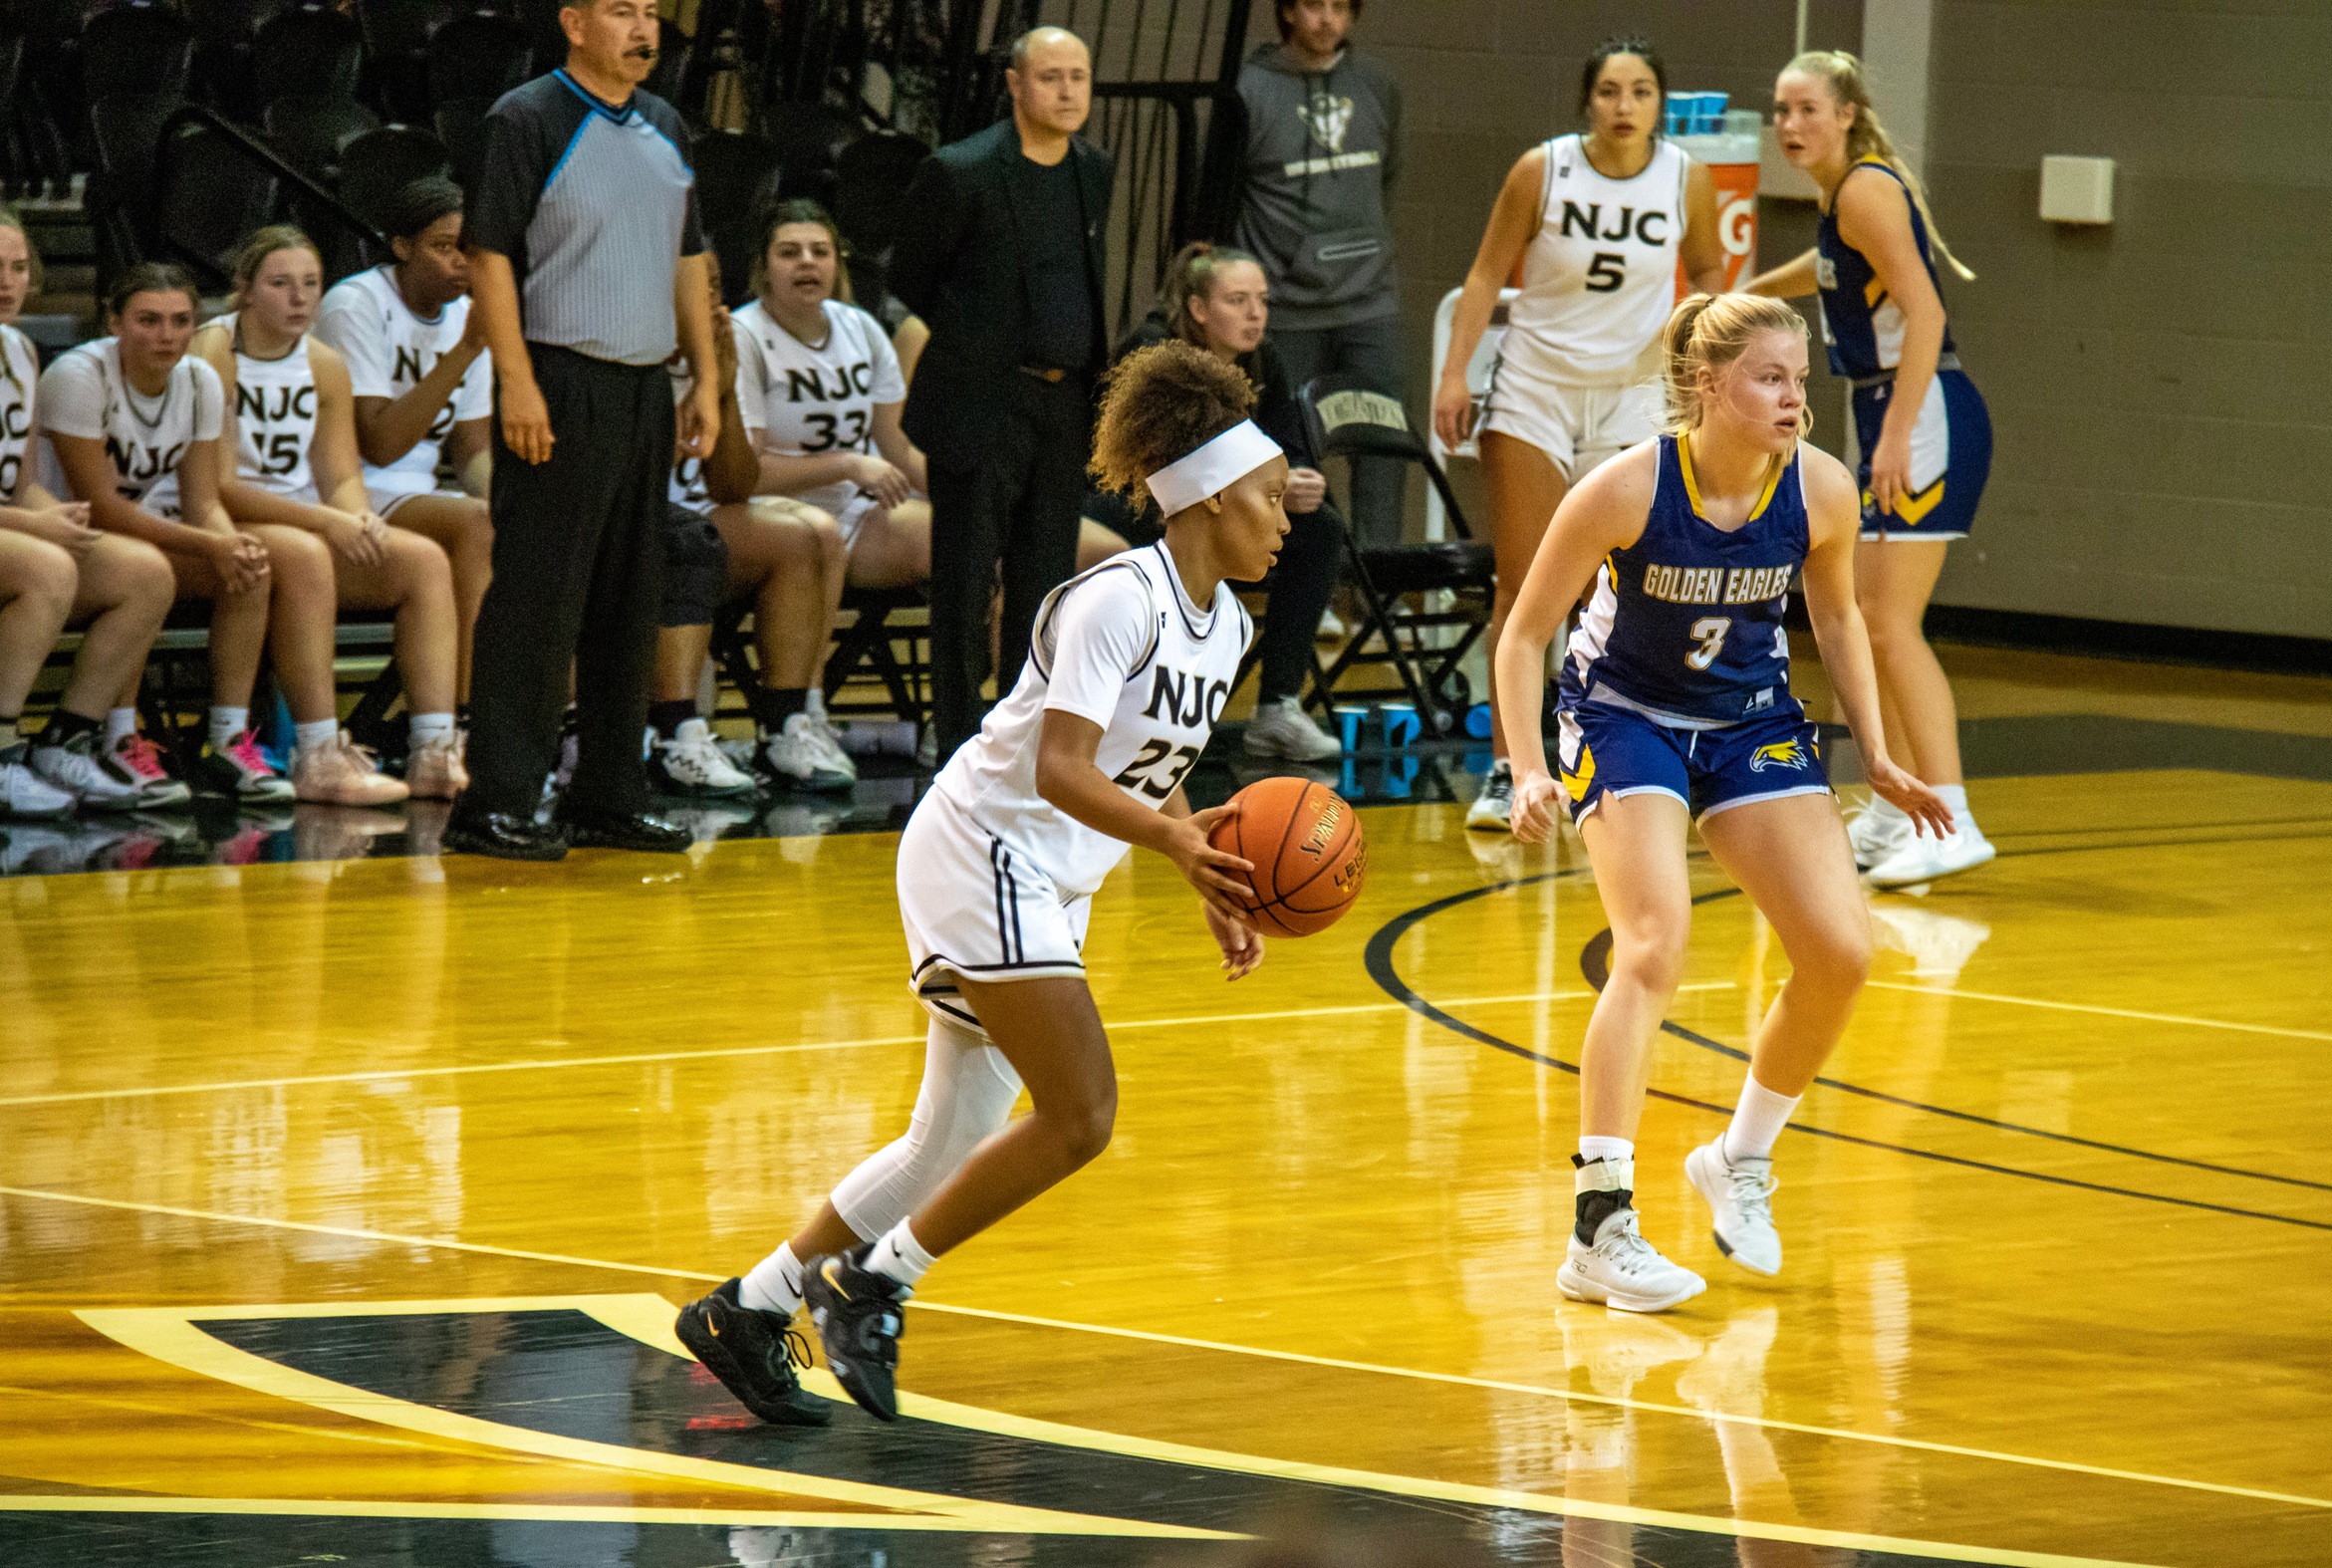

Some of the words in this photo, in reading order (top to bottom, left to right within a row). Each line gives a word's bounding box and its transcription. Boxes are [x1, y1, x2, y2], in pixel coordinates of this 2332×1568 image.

[1560, 200, 1669, 247] NJC
[1719, 199, 1753, 255] G
[1585, 252, 1626, 294] 5
[234, 382, 315, 423] NJC
[785, 362, 870, 402] NJC
[799, 409, 870, 454] 33
[1643, 563, 1724, 605] GOLDEN
[1723, 563, 1793, 605] EAGLES
[1684, 617, 1732, 671] 3
[1140, 664, 1228, 732] NJC
[1113, 738, 1199, 800] 23
